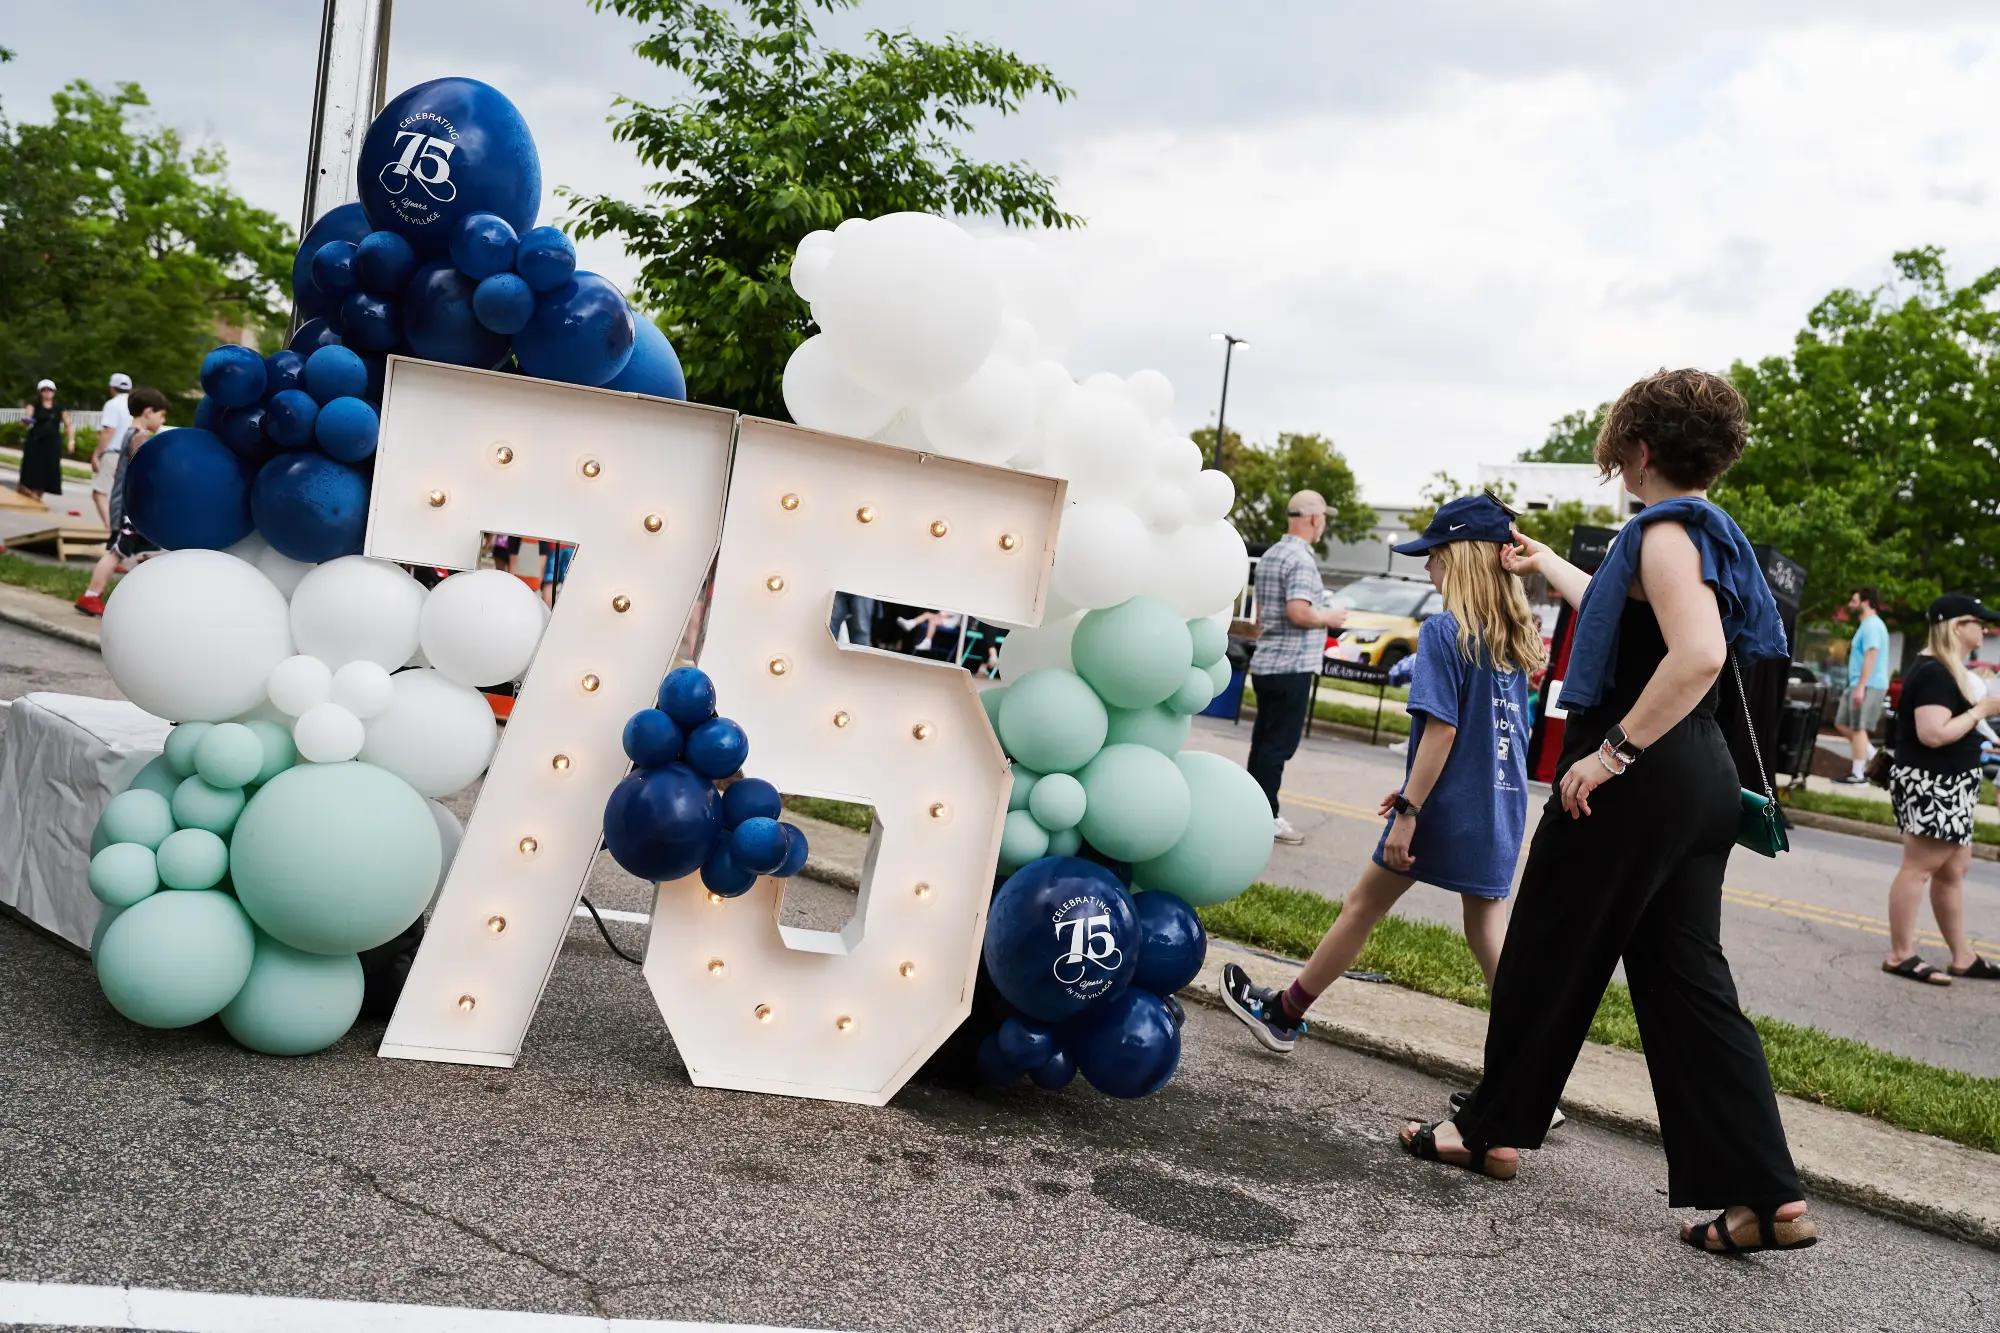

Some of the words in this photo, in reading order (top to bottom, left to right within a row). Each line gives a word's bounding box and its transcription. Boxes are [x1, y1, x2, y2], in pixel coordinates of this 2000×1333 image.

[400, 112, 460, 140] CELEBRATING
[379, 131, 456, 202] 75
[389, 199, 397, 209] IN
[396, 207, 409, 222] THE
[411, 211, 440, 225] VILLAGE
[401, 198, 428, 210] Years
[364, 354, 1068, 1106] 75
[1052, 896, 1111, 923] CELEBRATING
[1054, 915, 1122, 984] 75
[1073, 992, 1085, 1000] THE
[1087, 980, 1113, 999] VILLAGE
[1079, 979, 1104, 990] Years
